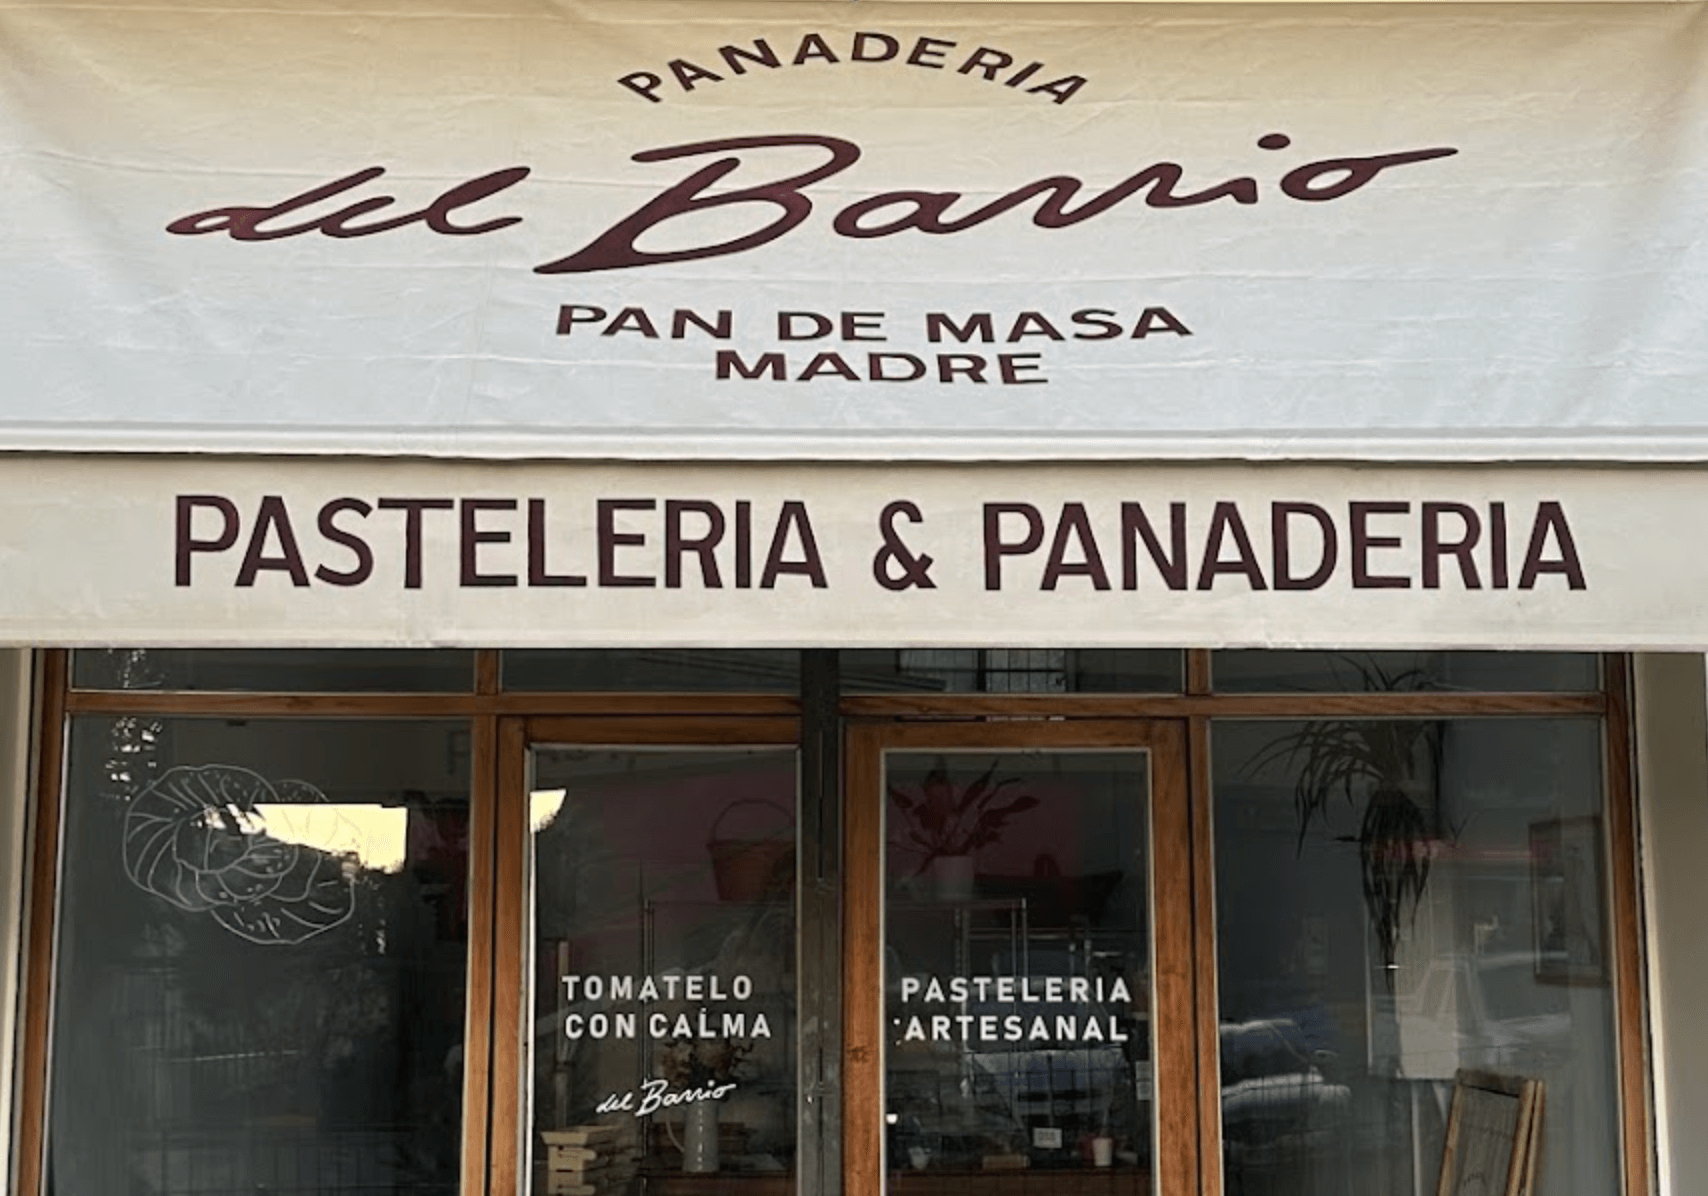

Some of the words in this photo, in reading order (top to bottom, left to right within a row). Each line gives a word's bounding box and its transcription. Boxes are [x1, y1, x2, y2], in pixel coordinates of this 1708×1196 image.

[617, 31, 1088, 105] PANADERIA
[166, 166, 531, 242] del
[533, 133, 1459, 275] Barrio
[555, 304, 733, 340] PAN
[777, 311, 887, 342] DE
[926, 307, 1193, 343] MASA
[715, 350, 1049, 385] MADRE
[175, 494, 829, 590] PASTELERIA
[872, 499, 937, 592] &
[982, 500, 1587, 592] PANADERIA
[561, 975, 752, 1001] TOMATELO
[901, 977, 1132, 1003] PASTELERIA
[564, 1013, 635, 1039] CON
[649, 1013, 771, 1039] CALMA
[904, 1015, 1129, 1041] ARTESANAL
[596, 1092, 633, 1113] del
[635, 1079, 737, 1117] Barrio
